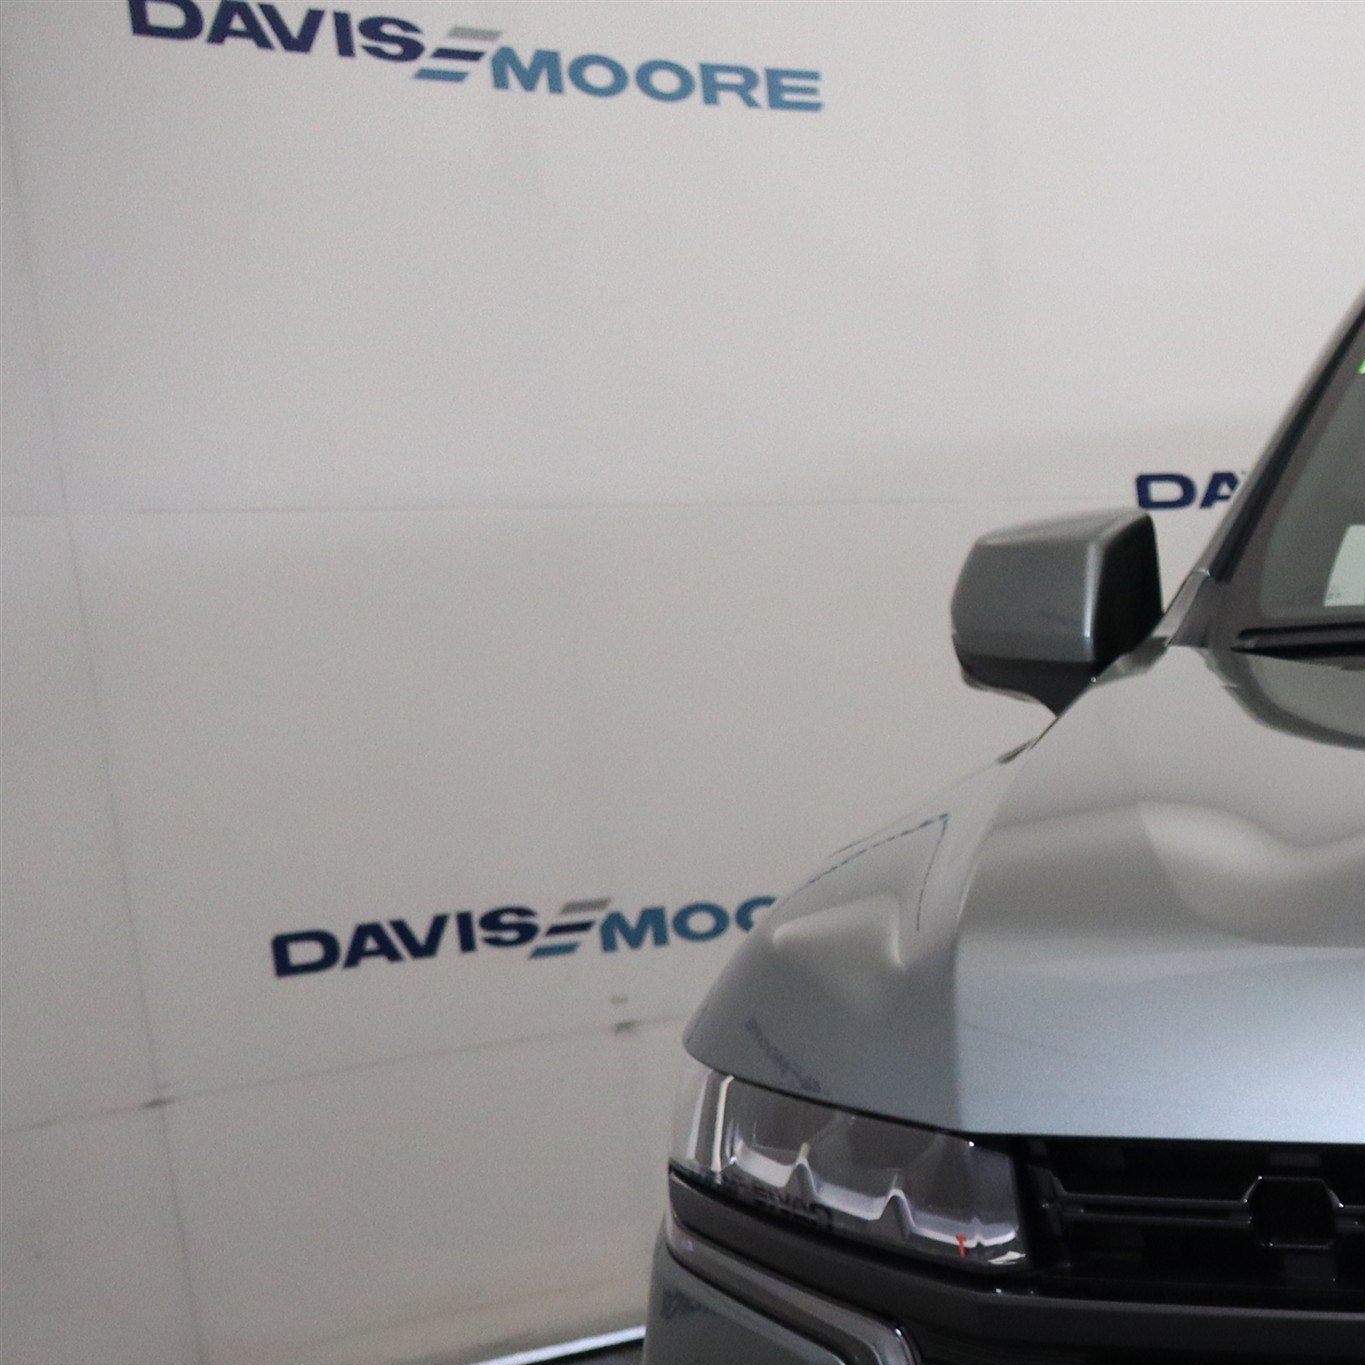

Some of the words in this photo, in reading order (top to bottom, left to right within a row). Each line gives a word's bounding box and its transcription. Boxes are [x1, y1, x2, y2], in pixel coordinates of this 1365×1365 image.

[129, 0, 425, 63] DAVIS
[491, 46, 824, 112] MOORE
[271, 906, 541, 977] DAVIS
